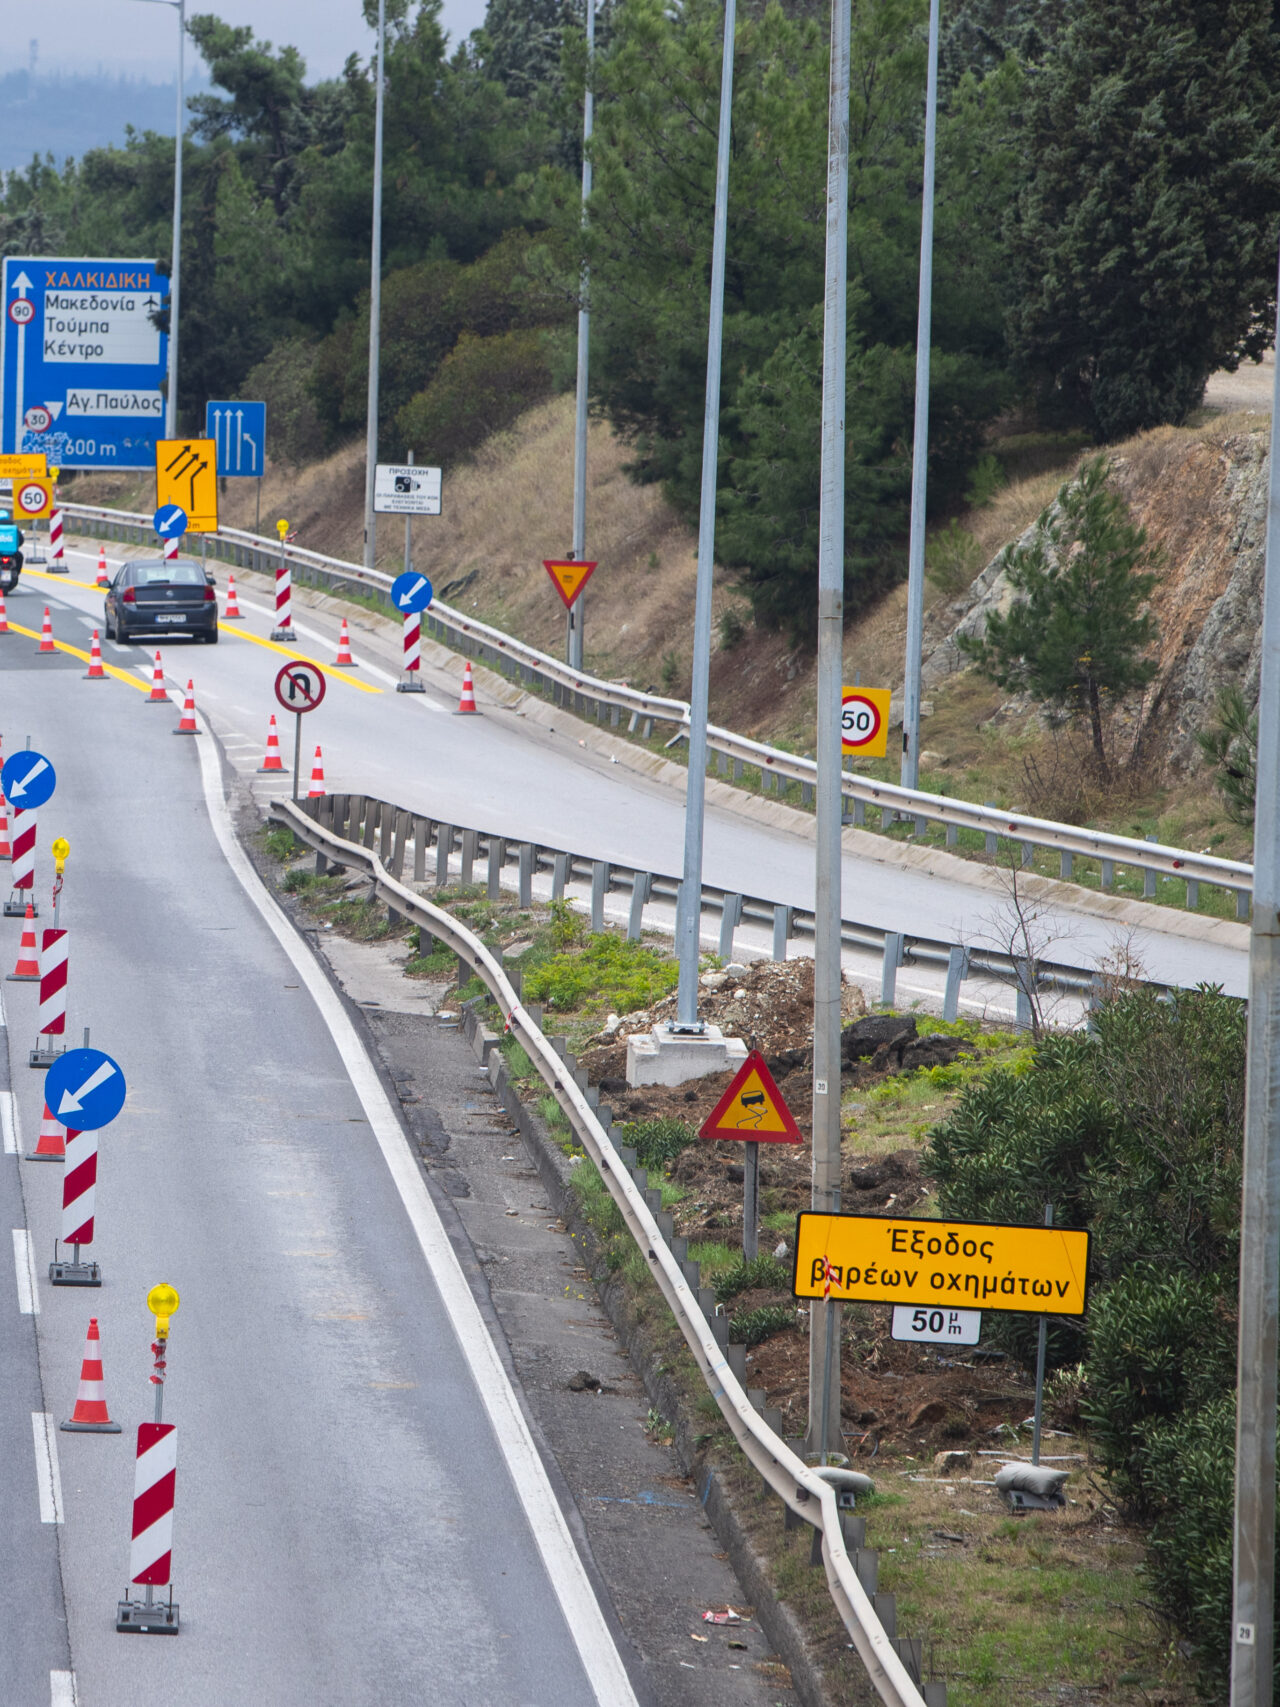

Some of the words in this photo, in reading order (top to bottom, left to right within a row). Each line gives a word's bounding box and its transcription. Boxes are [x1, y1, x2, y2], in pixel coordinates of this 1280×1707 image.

[45, 271, 150, 289] ΧΑΛΚΙΔΙΚΗ
[14, 305, 30, 318] 90
[45, 294, 135, 311] Μακεδονία
[47, 317, 109, 336] Τούμπα
[44, 339, 104, 359] Κέντρο
[30, 413, 46, 426] 30
[65, 439, 96, 455] 600
[100, 443, 116, 456] m
[389, 467, 429, 476] ΠΡΟΣΟΧΗ
[24, 492, 42, 505] 50
[841, 710, 870, 731] 50
[886, 1229, 994, 1264] Έξοδος
[810, 1258, 918, 1290] βαρέων
[930, 1270, 1070, 1298] οχημάτων
[911, 1310, 944, 1333] 50
